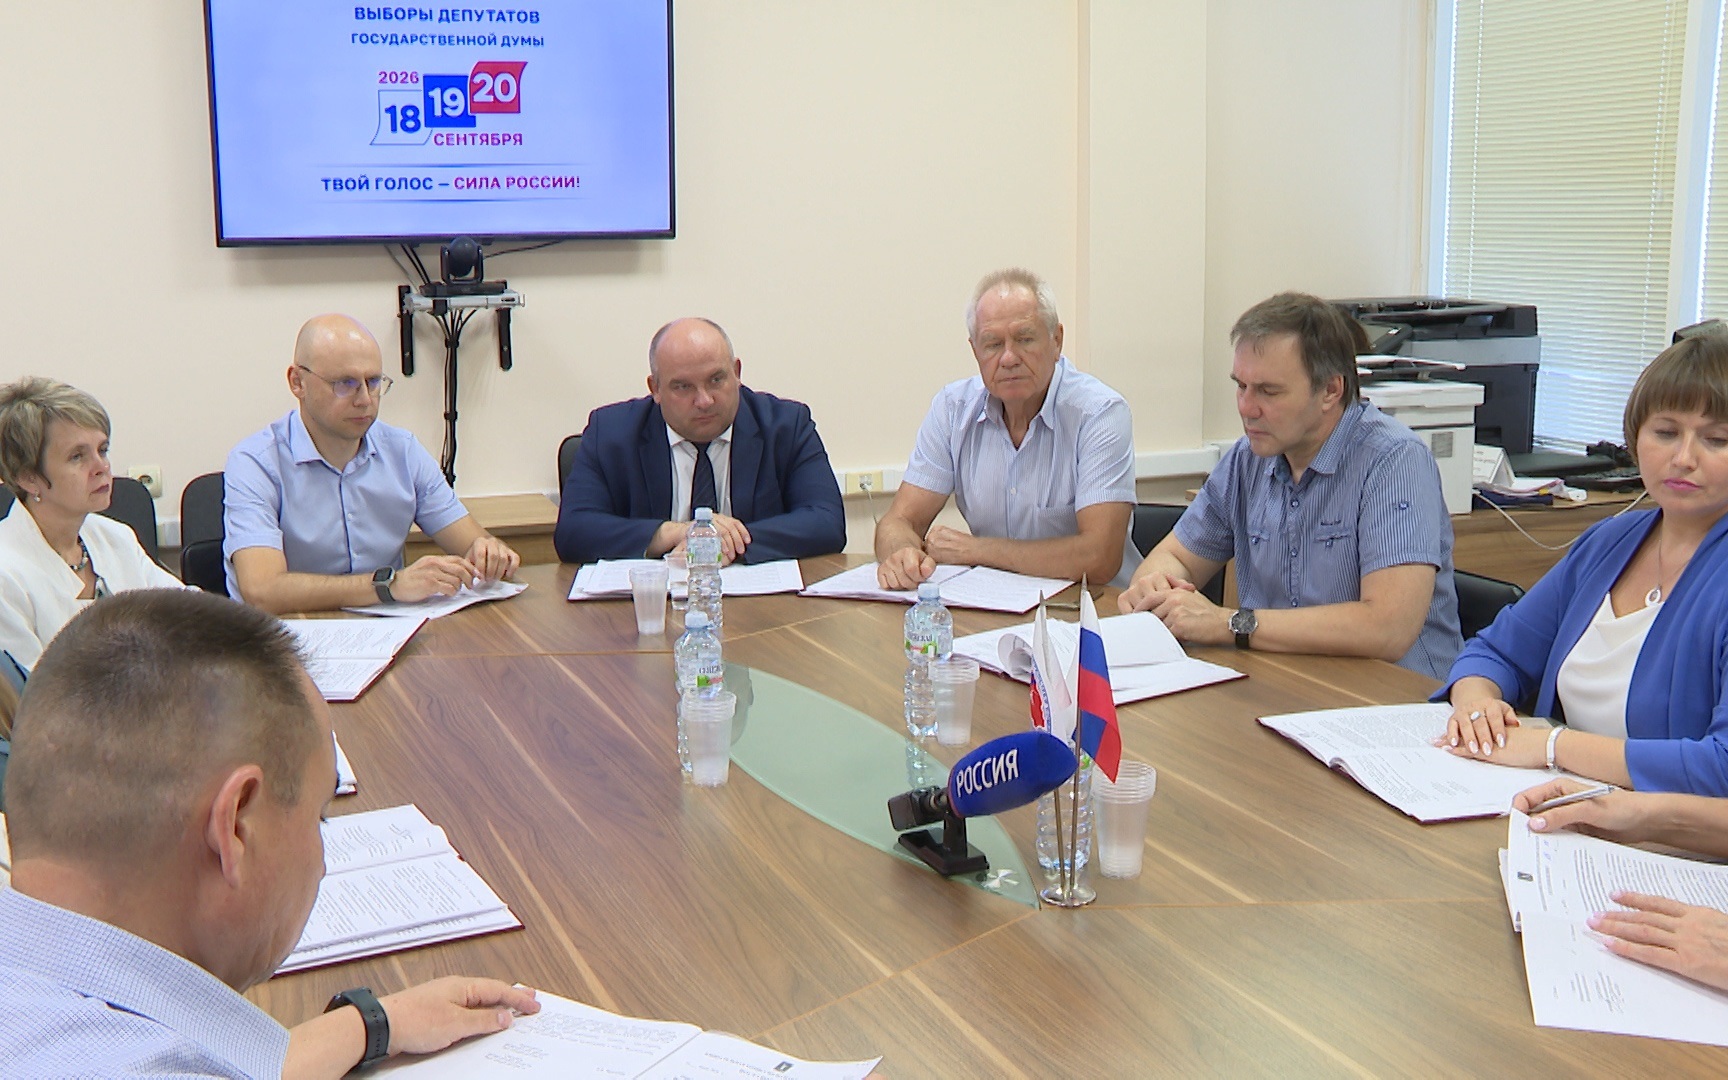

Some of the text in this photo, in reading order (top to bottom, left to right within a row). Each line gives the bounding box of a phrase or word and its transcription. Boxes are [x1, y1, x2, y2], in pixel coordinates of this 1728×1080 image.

[354, 7, 540, 24] ВЫБОРЫ ДЕПУТАТОВ
[351, 32, 544, 48] ГОСУДАРСТВЕННОЙ ДУМЫ
[378, 71, 419, 84] 2026
[384, 71, 517, 134] 18 19 20
[433, 133, 523, 146] СЕНТЯБРЯ
[321, 174, 370, 191] ТВОЙ
[375, 177, 433, 190] ГОЛОС
[454, 176, 501, 190] СИЛА
[505, 175, 580, 190] РОССИИ!
[956, 748, 1019, 798] РОССИЯ
